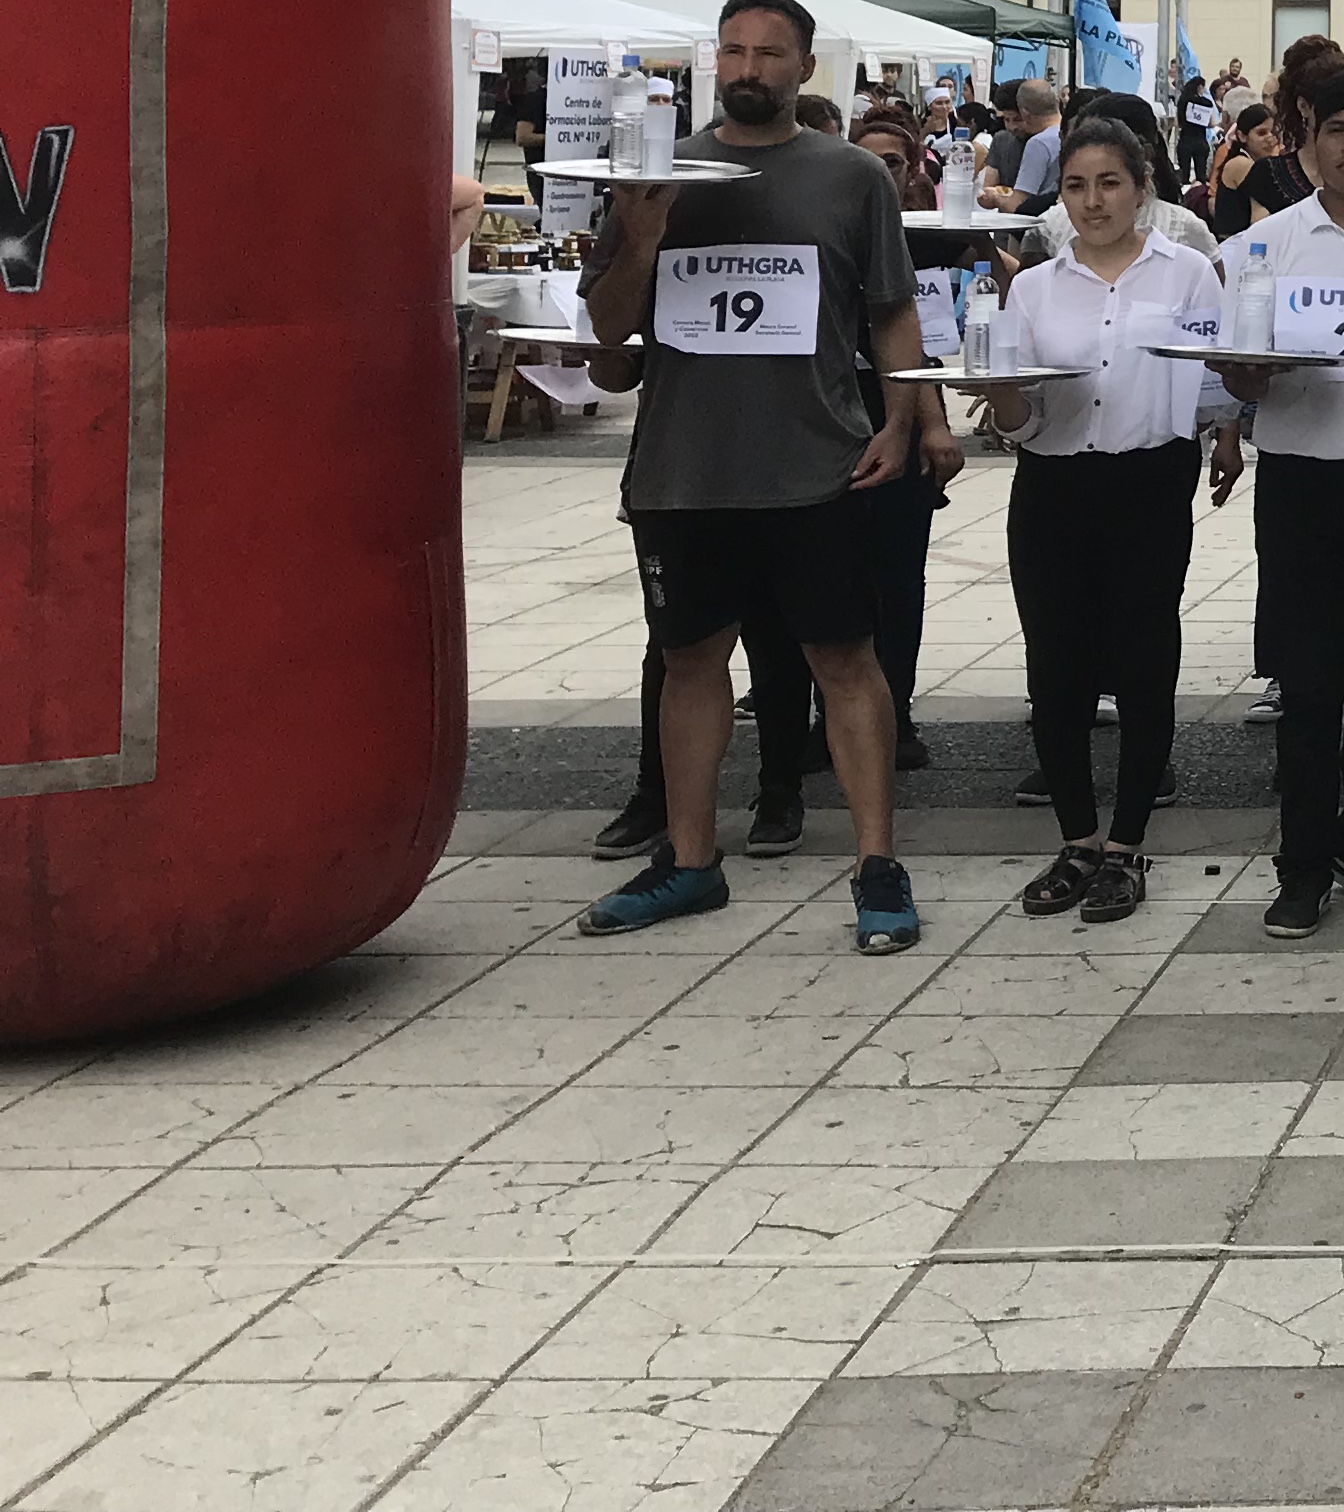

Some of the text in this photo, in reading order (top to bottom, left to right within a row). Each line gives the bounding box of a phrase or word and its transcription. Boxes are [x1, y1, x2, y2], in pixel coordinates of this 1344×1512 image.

[1080, 20, 1099, 39] LA
[571, 59, 608, 78] UTHGR
[706, 256, 805, 275] UTHGRA
[710, 290, 764, 333] 19
